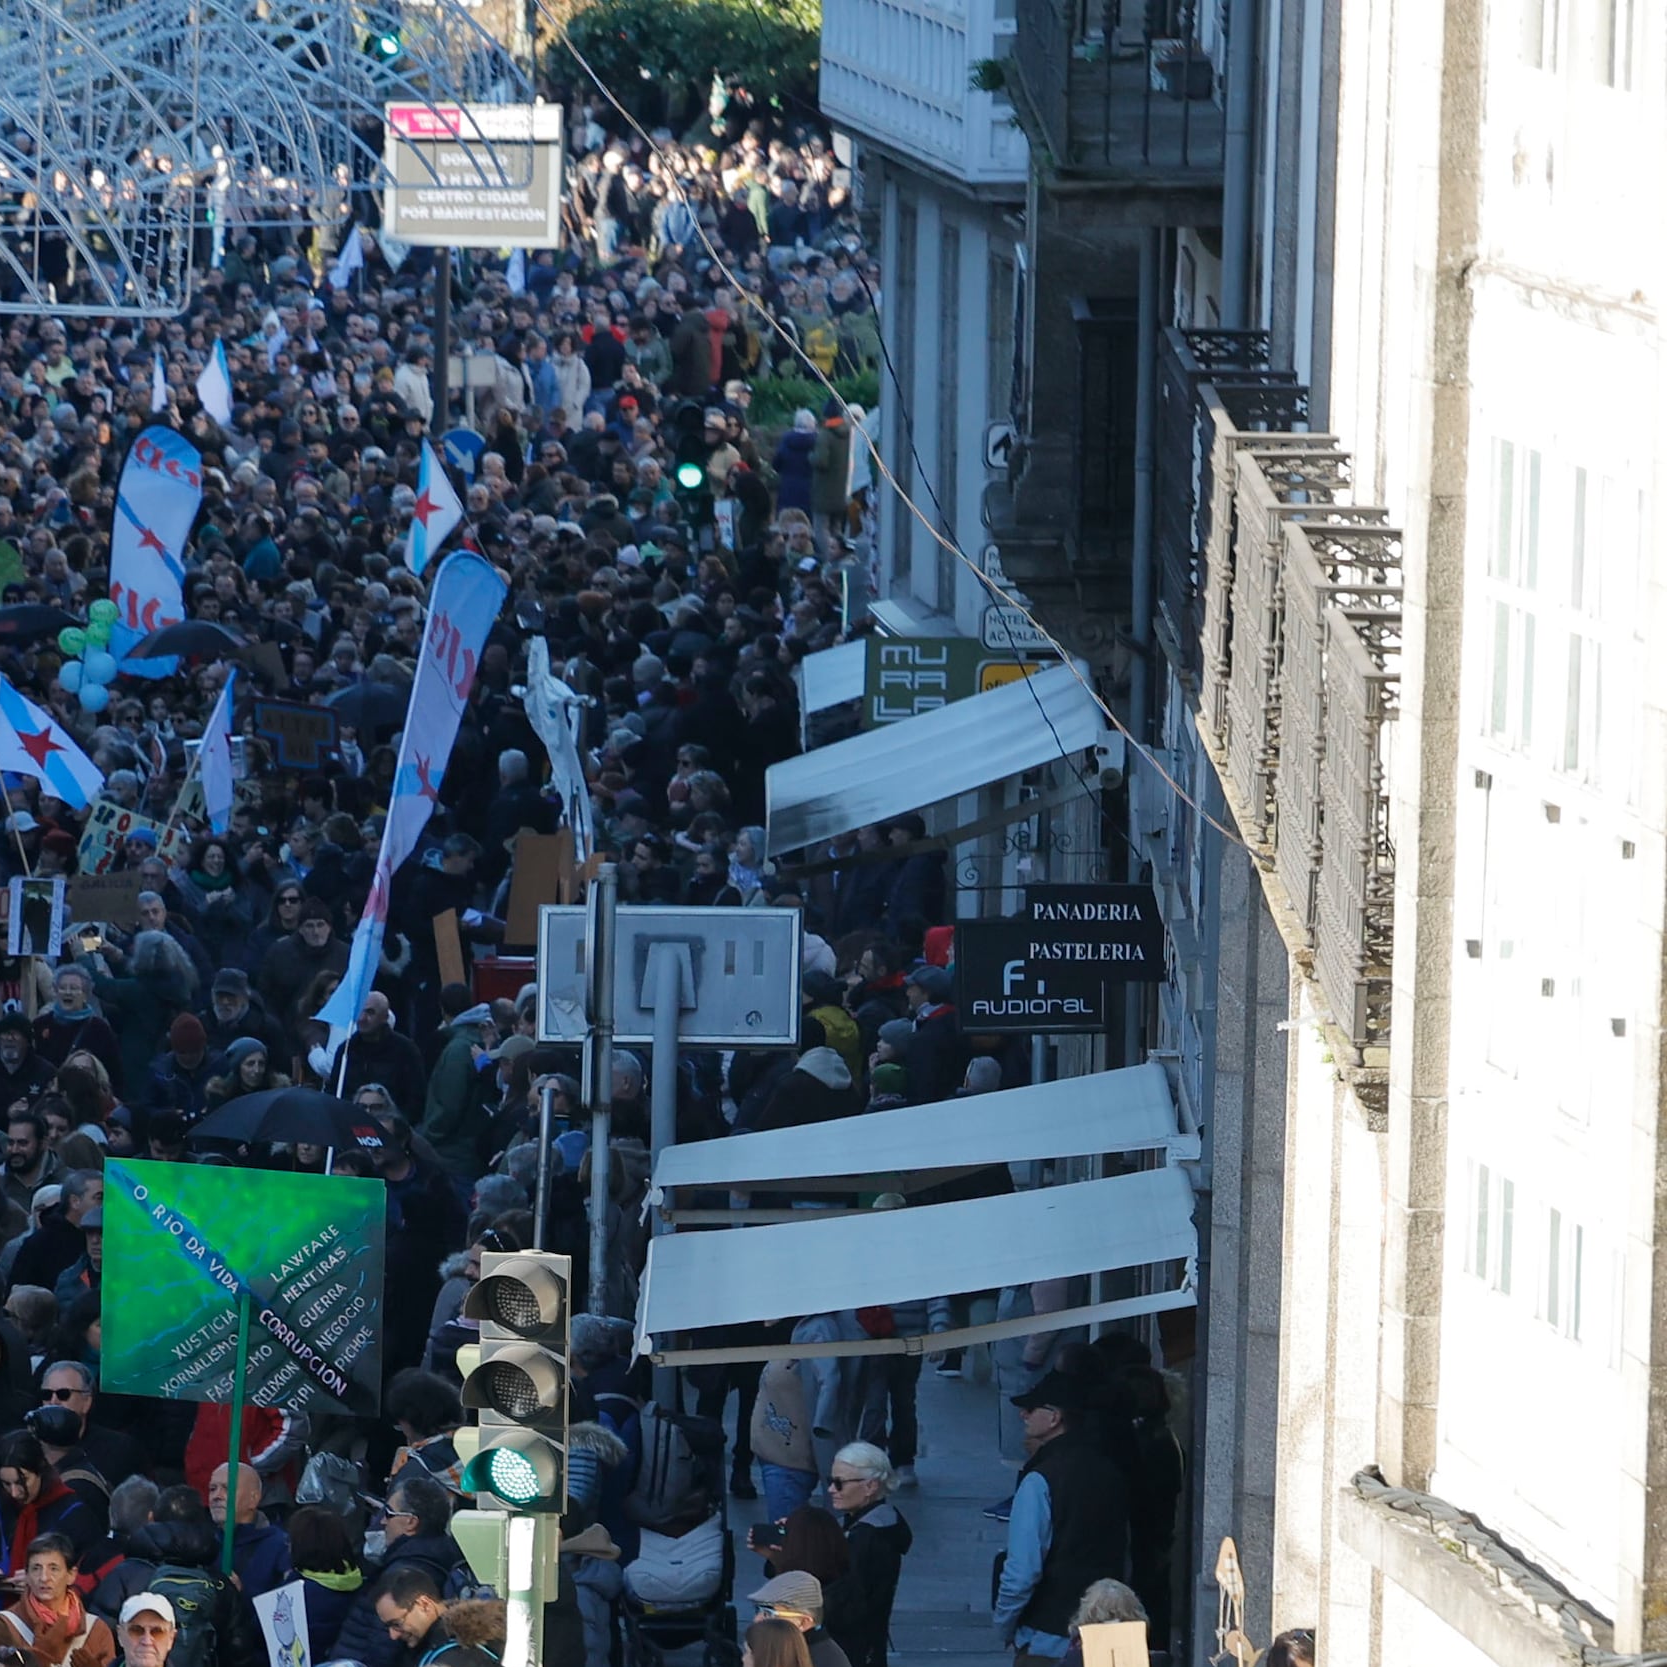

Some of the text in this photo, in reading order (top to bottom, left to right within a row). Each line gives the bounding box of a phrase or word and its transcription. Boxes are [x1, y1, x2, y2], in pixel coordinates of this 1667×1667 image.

[401, 207, 430, 219] POR
[417, 190, 529, 205] CENTRO CIDADE
[989, 614, 1030, 626] HOTEL
[989, 631, 1006, 643] AC
[1033, 901, 1142, 922] PANADERIA
[1028, 940, 1145, 962] PASTELERIA
[356, 1136, 384, 1147] NON
[134, 1185, 148, 1200] O
[185, 1235, 206, 1260] DA
[208, 1258, 240, 1294] VIDA
[270, 1224, 340, 1283] LAWFARE
[282, 1246, 347, 1304] MENTIRAS
[298, 1283, 347, 1328] GUERRA
[171, 1309, 238, 1361] XUSTICIA
[259, 1309, 348, 1396] CORRUPCION
[160, 1334, 239, 1397] XORNALISMO
[204, 1345, 273, 1403] FASCSMO
